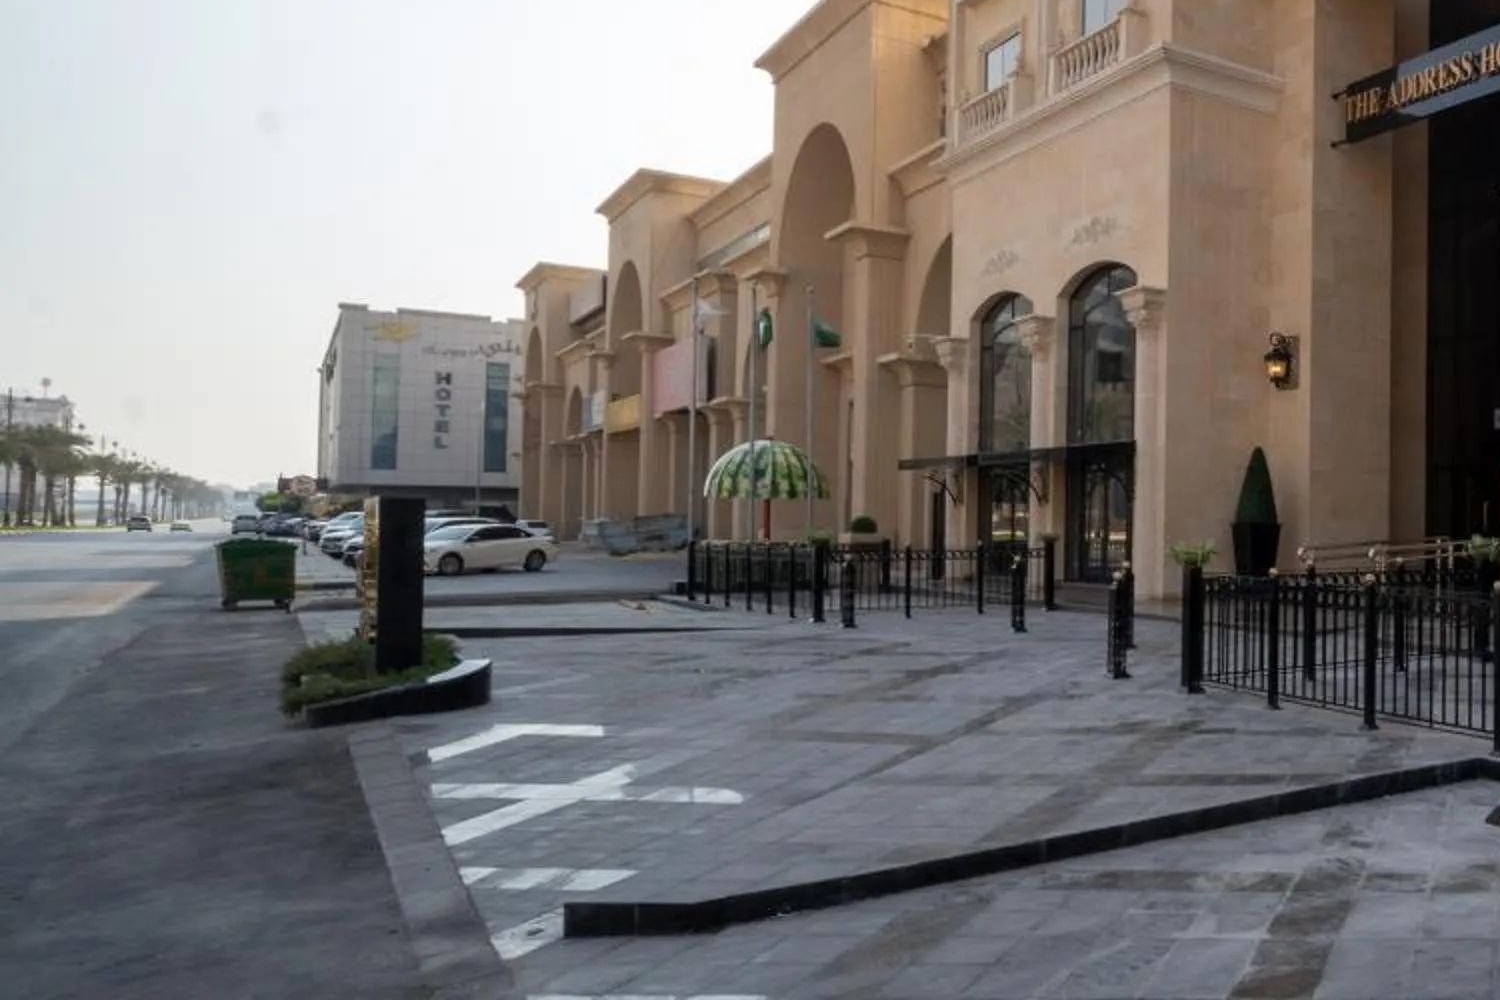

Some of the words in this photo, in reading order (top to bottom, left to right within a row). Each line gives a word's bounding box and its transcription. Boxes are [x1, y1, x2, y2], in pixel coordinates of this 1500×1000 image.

[1344, 87, 1381, 123] THE
[1386, 50, 1473, 109] ADDRESS
[434, 371, 453, 450] HOTEL
